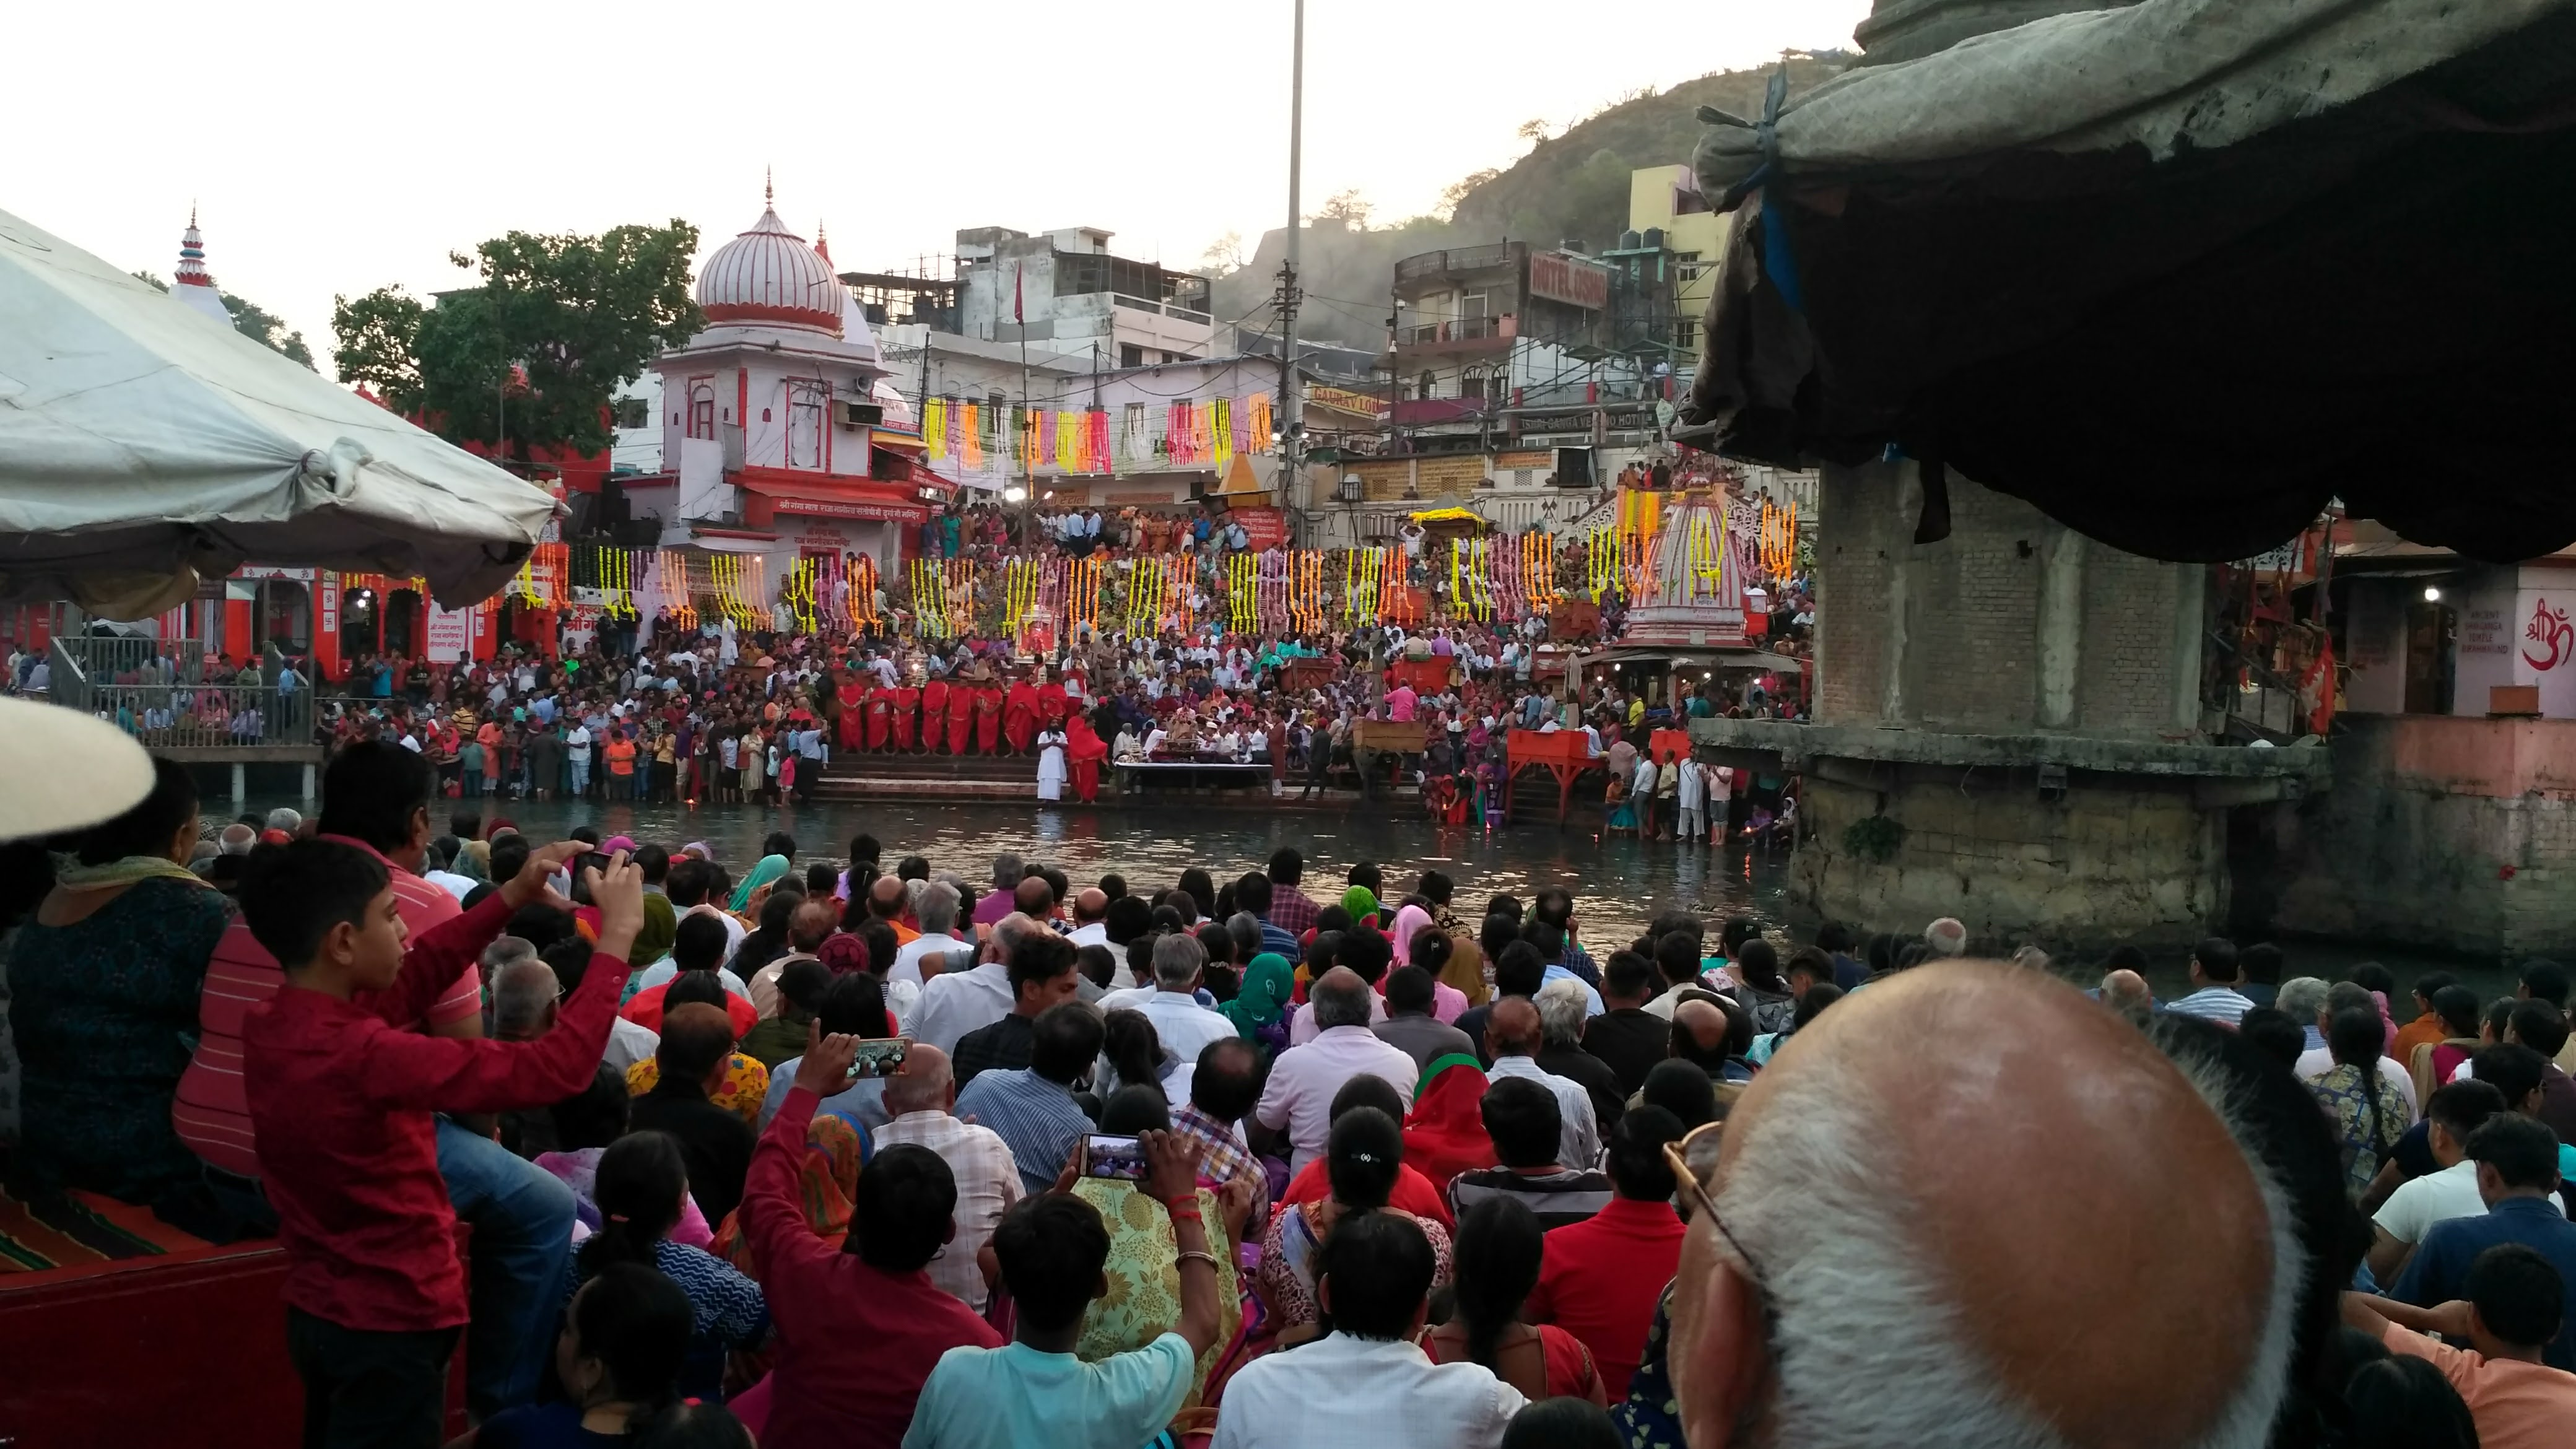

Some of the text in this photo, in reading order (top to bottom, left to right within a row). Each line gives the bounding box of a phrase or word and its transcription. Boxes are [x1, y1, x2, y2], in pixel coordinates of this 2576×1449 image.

[1533, 256, 1606, 306] HOTEL OSHO
[1315, 387, 1378, 414] GAURAV LOD
[779, 499, 790, 509] श्री
[790, 501, 804, 510] गंगा
[820, 505, 833, 513] राजा
[902, 510, 921, 520] मन्दिर
[565, 616, 583, 631] श्री
[2469, 633, 2494, 642] TEMPLE
